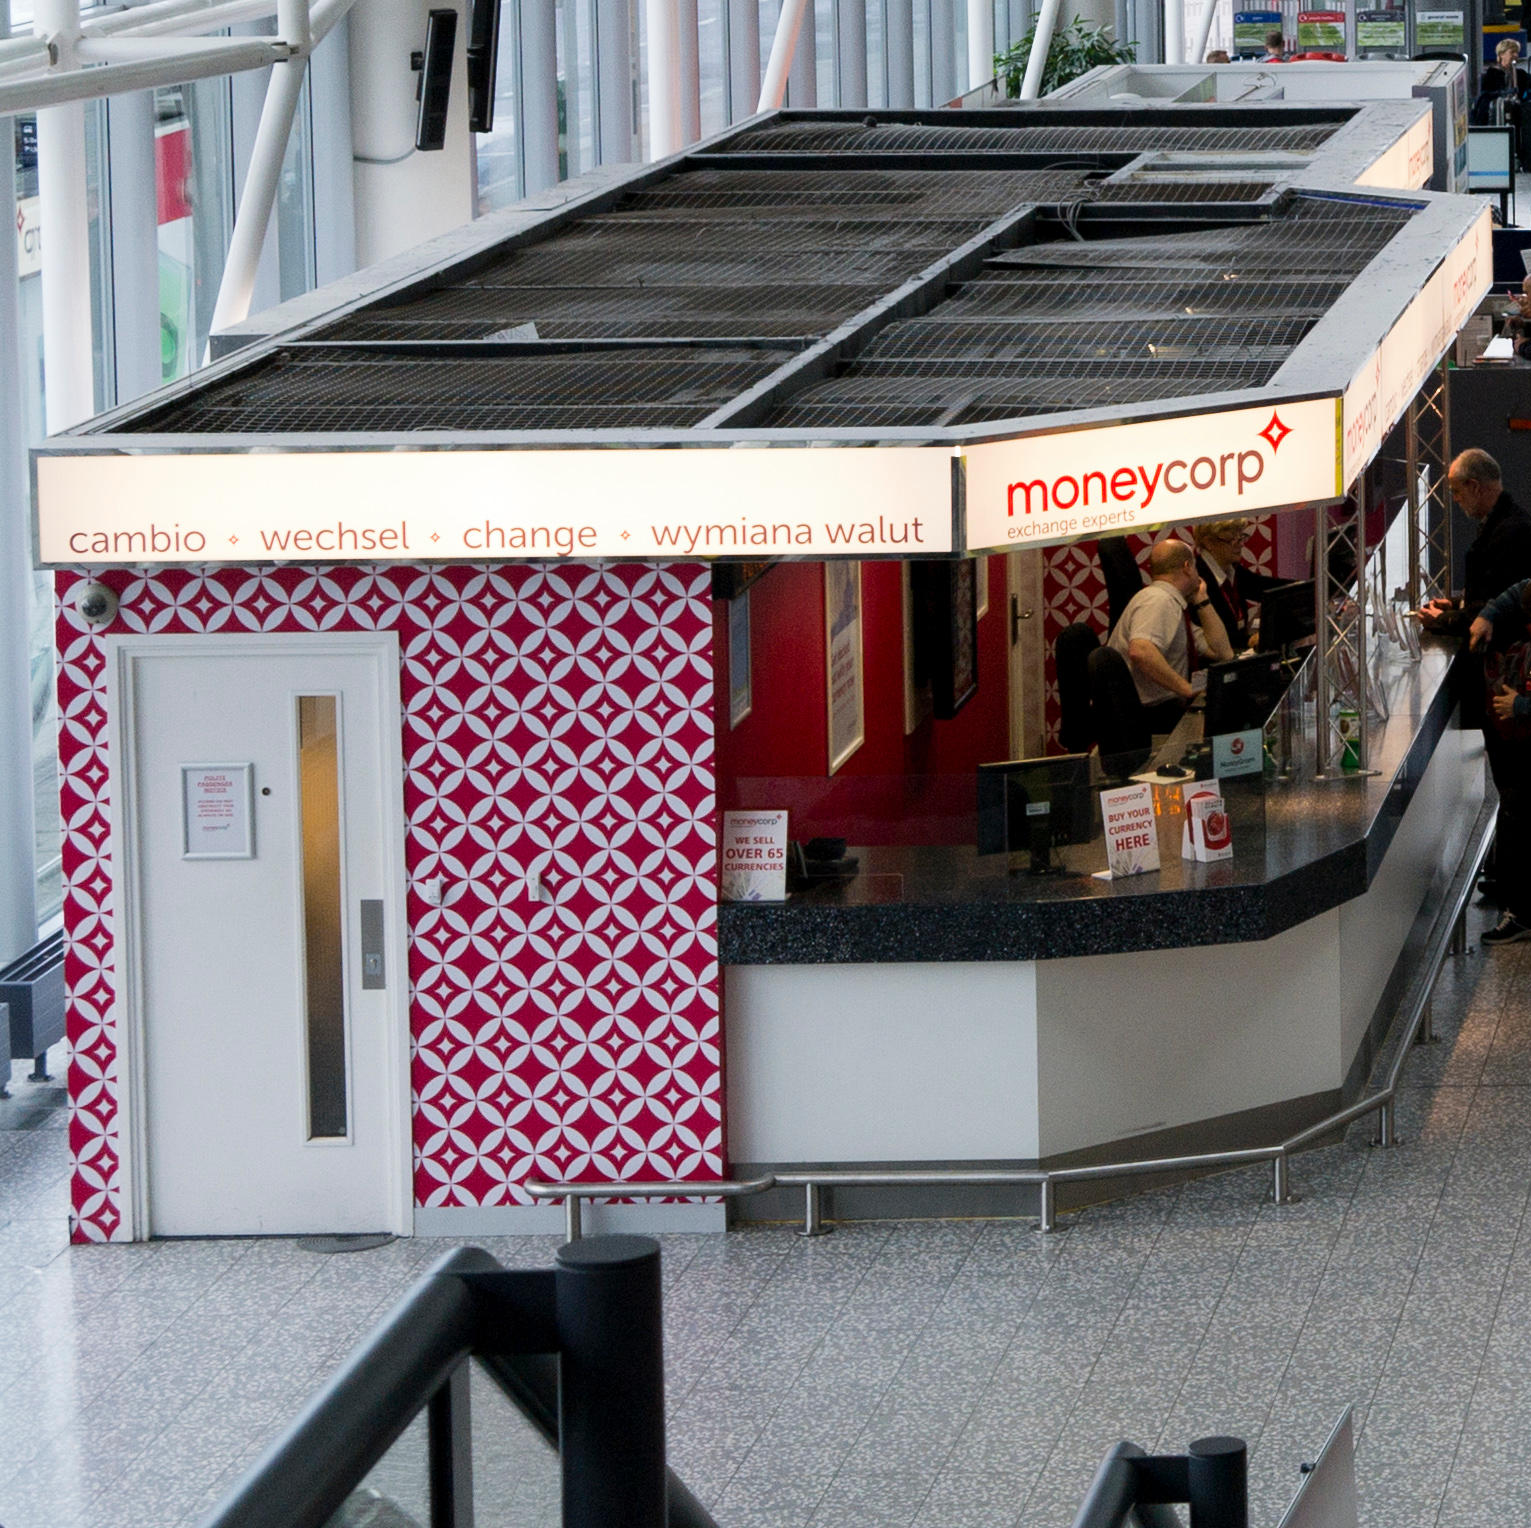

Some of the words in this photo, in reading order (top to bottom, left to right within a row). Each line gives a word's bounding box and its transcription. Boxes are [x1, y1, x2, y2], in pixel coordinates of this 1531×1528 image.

[1007, 449, 1264, 517] moneycorp
[1007, 516, 1078, 539] exchange
[1082, 508, 1135, 530] experts
[69, 524, 206, 554] cambio
[260, 521, 410, 551] wechsel
[463, 520, 597, 556] change
[651, 517, 812, 554] wymiana
[826, 516, 924, 544] walut
[1107, 792, 1144, 804] moneycorp
[730, 818, 777, 826] moneycorp
[1108, 813, 1125, 823] BUY
[1128, 808, 1150, 818] YOUR
[1108, 820, 1153, 835] CURRENCY
[1115, 834, 1150, 851] HERE
[726, 848, 763, 859] OVER
[767, 848, 784, 859] 65
[724, 863, 784, 871] CURRENCIES
